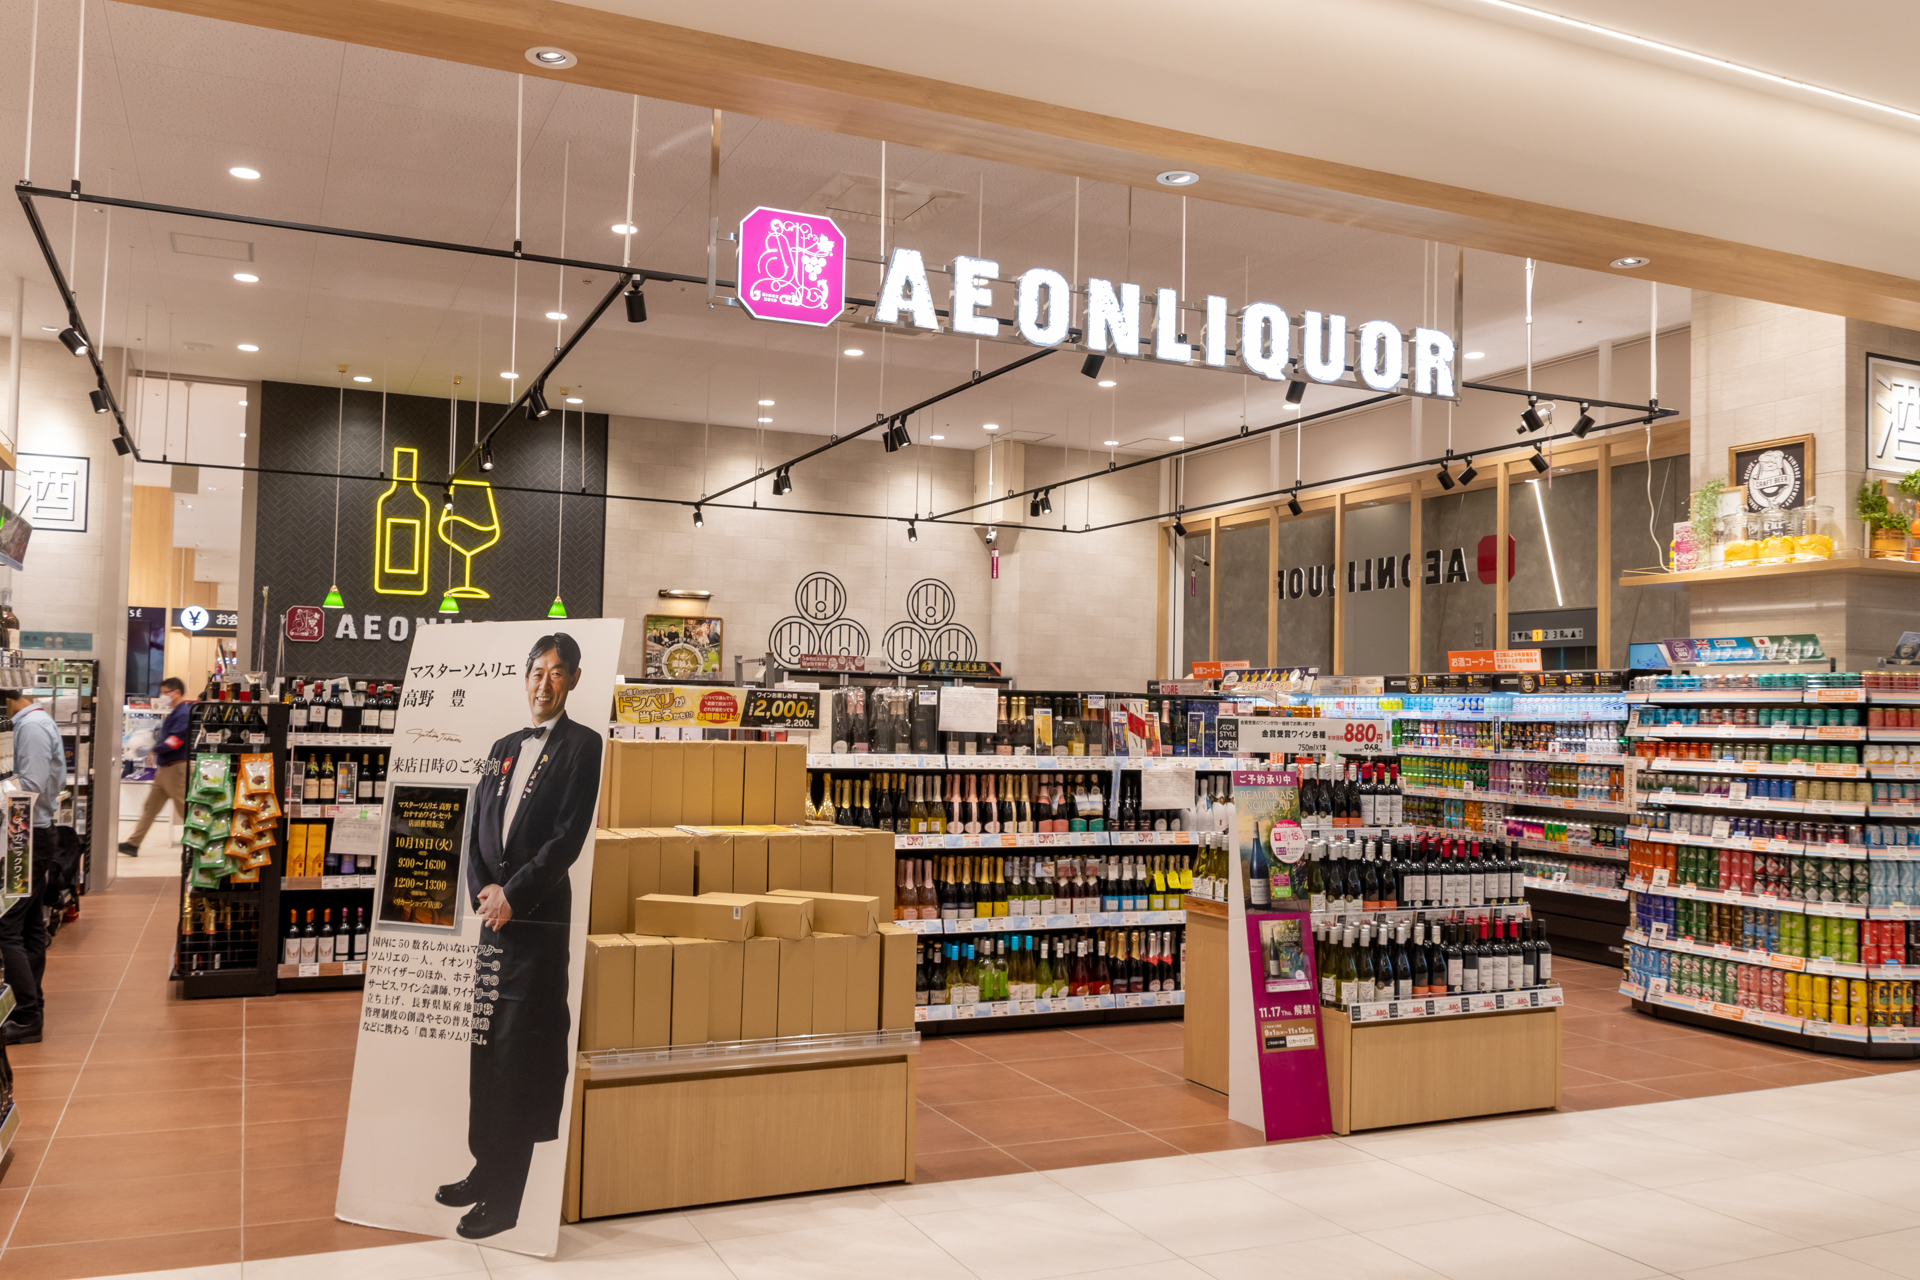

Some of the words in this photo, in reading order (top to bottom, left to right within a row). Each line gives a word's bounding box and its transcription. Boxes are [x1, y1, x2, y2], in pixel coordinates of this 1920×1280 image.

[874, 247, 1455, 397] AEONLIQUOR
[1755, 479, 1772, 488] CRAFT
[1774, 475, 1788, 483] BEER
[16, 469, 79, 521] 酒
[1450, 656, 1493, 667] お酒コーナー
[410, 661, 517, 680] マスターソムリエ
[1161, 684, 1179, 695] CIDRE
[403, 689, 435, 708] 高野
[449, 689, 466, 708] 豊
[1261, 729, 1326, 739] 金賞受賞ワイン各種
[1218, 740, 1238, 748] OPEN
[390, 757, 501, 776] 来店日時のご案内
[1239, 774, 1292, 785] ご予約承り中
[1245, 800, 1291, 810] NOUVEAU
